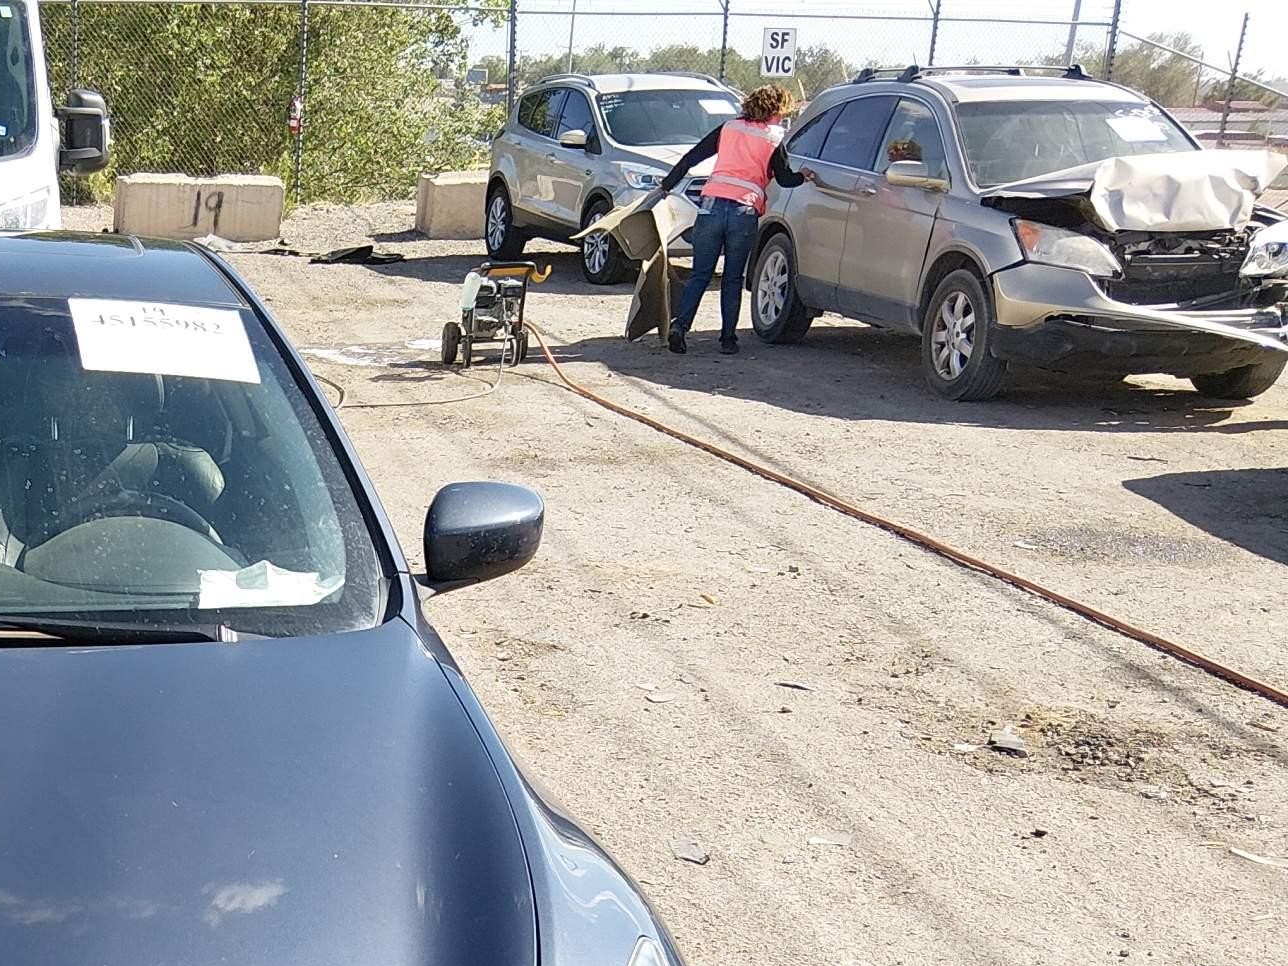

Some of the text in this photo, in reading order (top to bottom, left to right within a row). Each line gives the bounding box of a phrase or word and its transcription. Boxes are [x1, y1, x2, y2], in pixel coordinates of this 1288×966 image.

[769, 32, 790, 49] SF
[764, 55, 792, 73] VIC
[192, 190, 225, 233] 19
